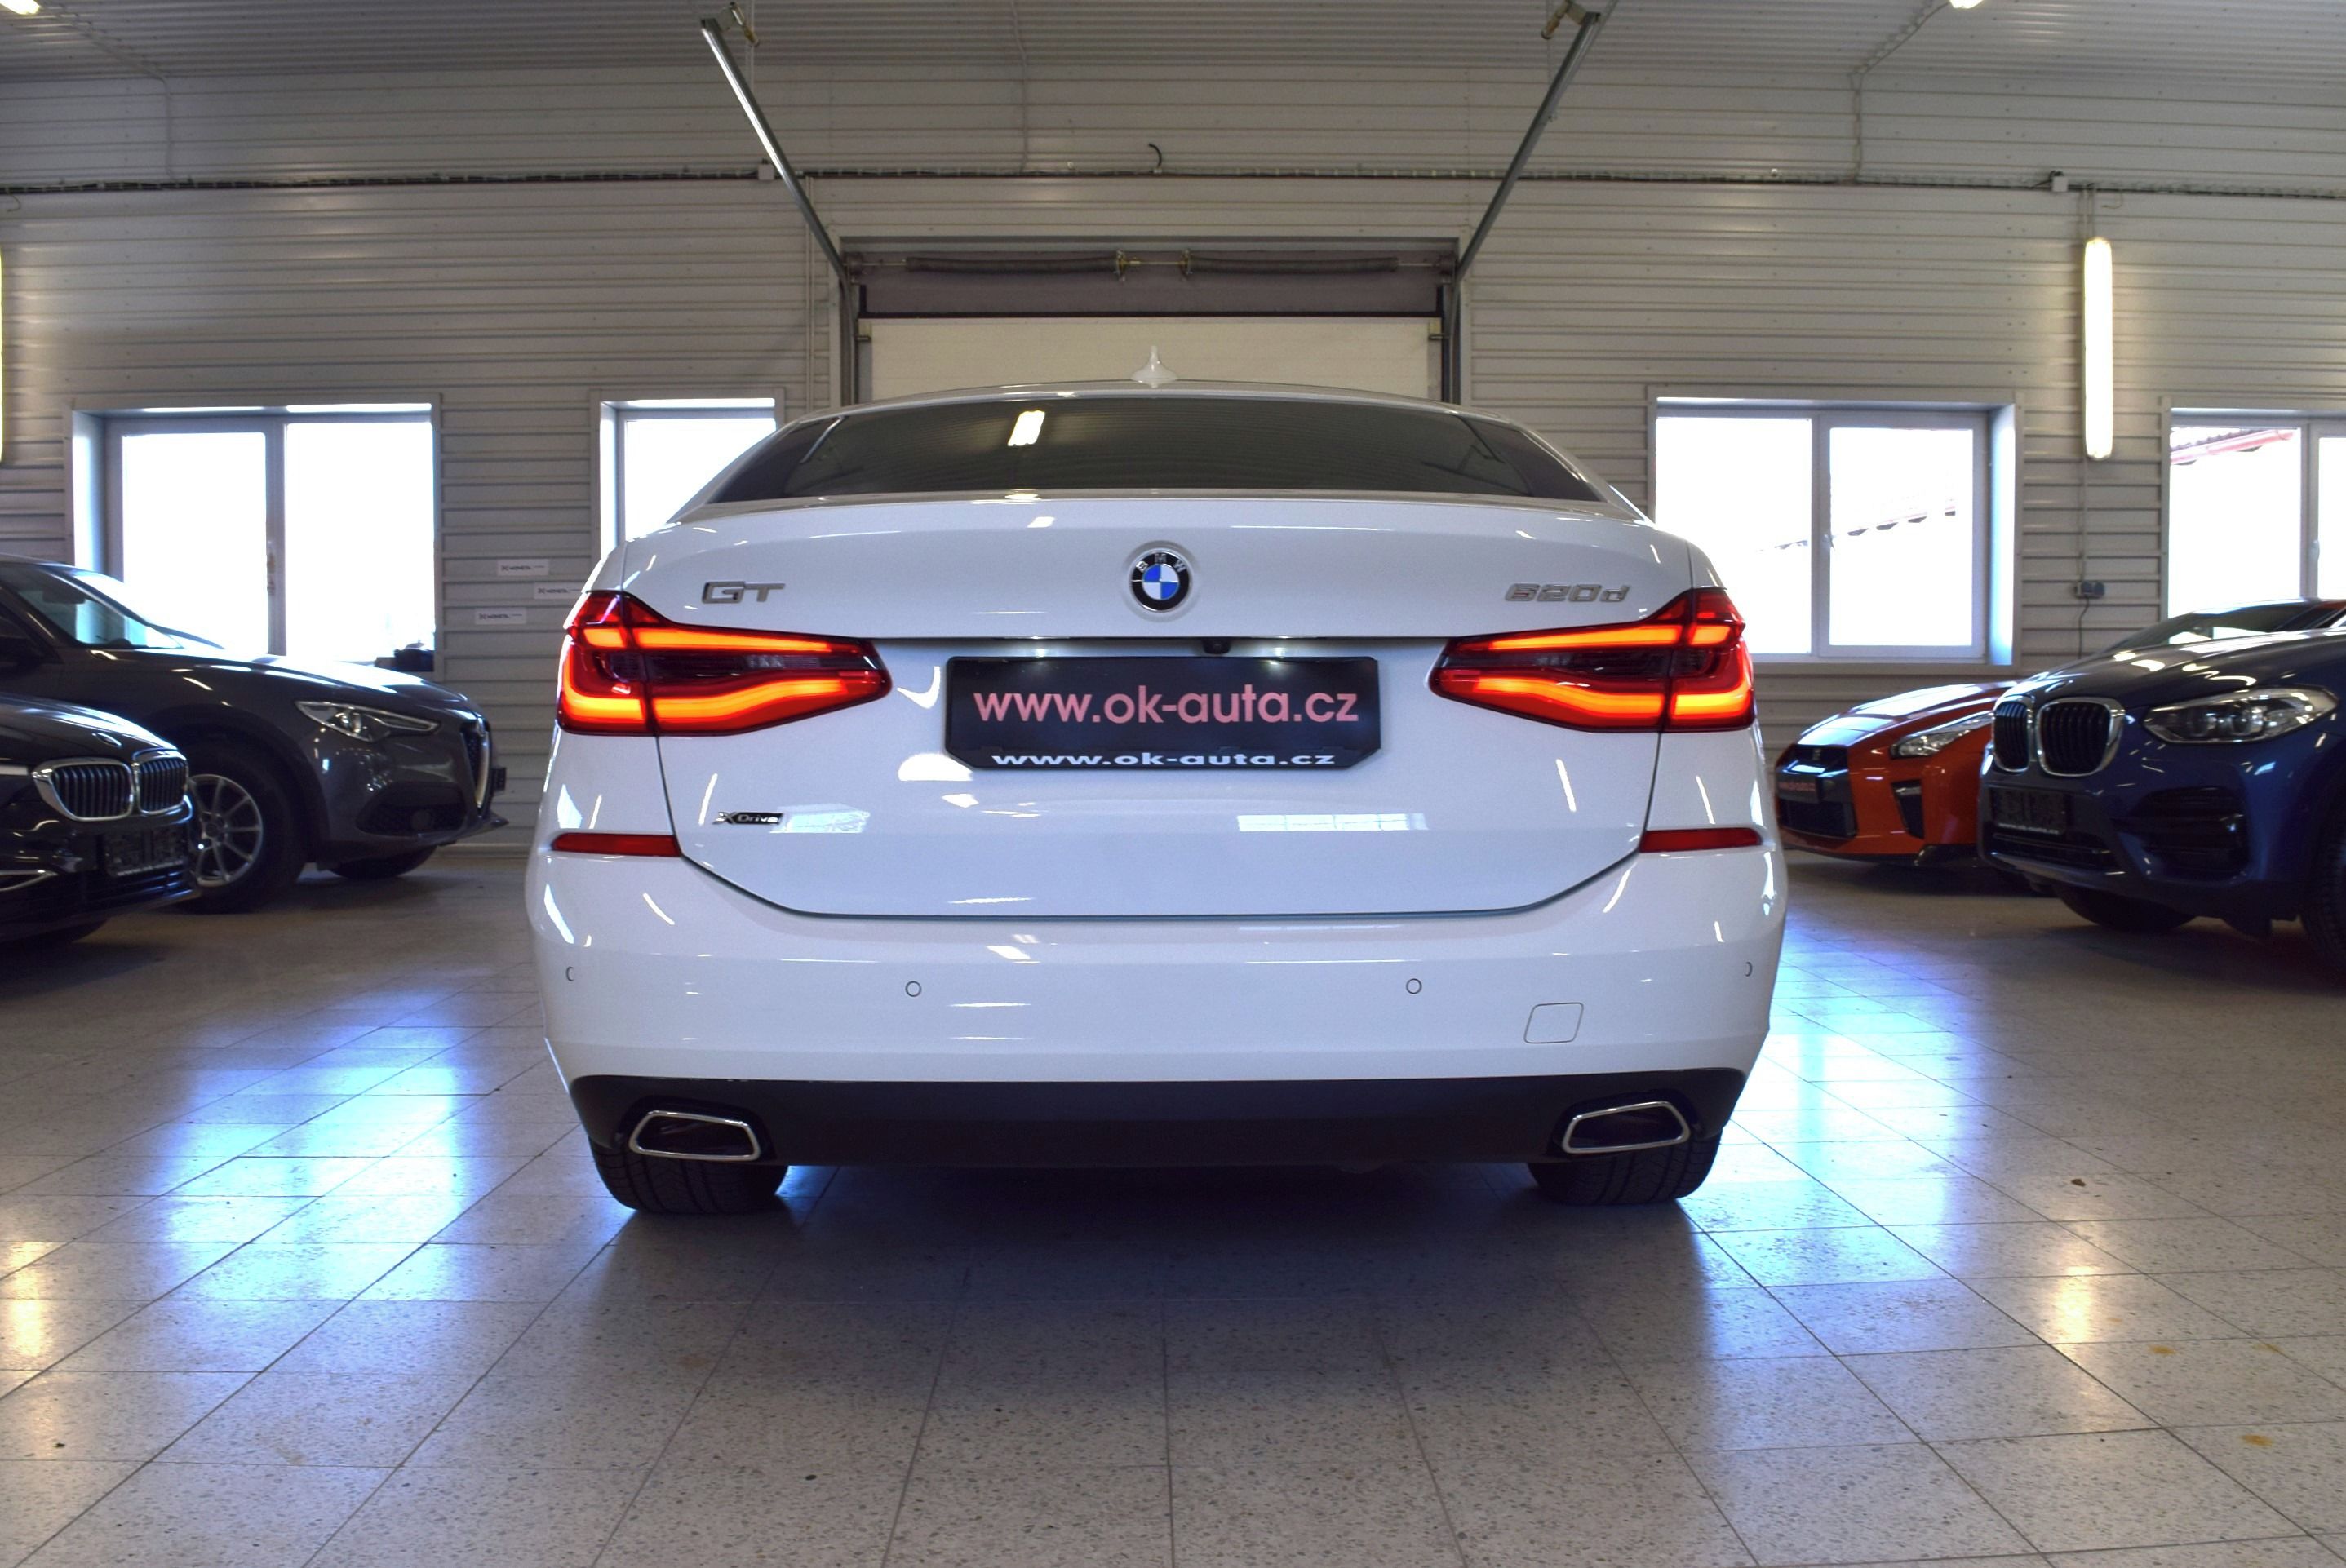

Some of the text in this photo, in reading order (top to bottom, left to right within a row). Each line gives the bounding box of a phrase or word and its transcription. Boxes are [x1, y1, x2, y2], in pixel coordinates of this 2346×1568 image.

[1135, 553, 1186, 573] BMW
[702, 580, 785, 604] GT
[1505, 582, 1630, 602] 620d
[973, 684, 1359, 724] www.ok-auta.cz
[991, 751, 1336, 766] www.ok-auta.cz
